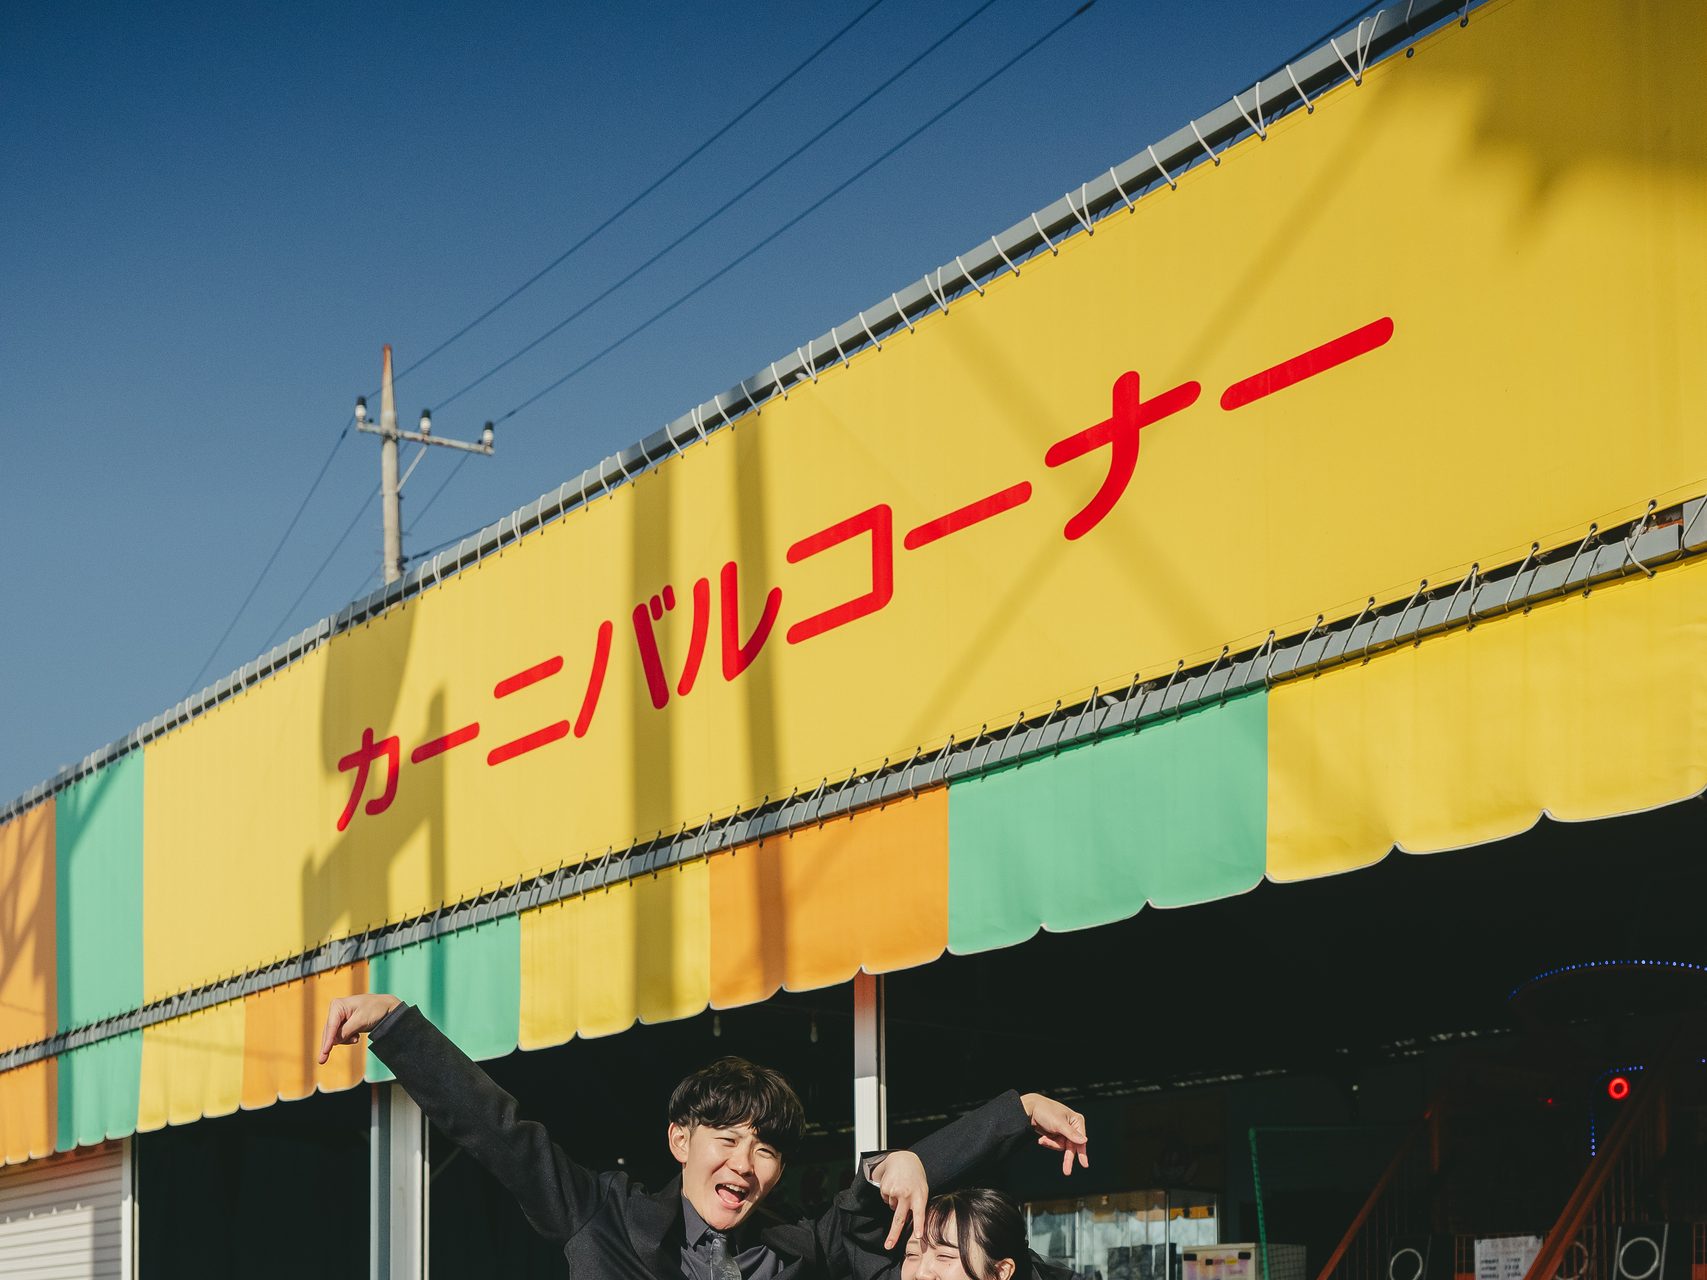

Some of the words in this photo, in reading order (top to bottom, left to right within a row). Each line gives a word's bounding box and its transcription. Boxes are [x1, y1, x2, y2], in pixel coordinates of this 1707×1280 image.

[337, 316, 1394, 832] カーニバルコーナー
